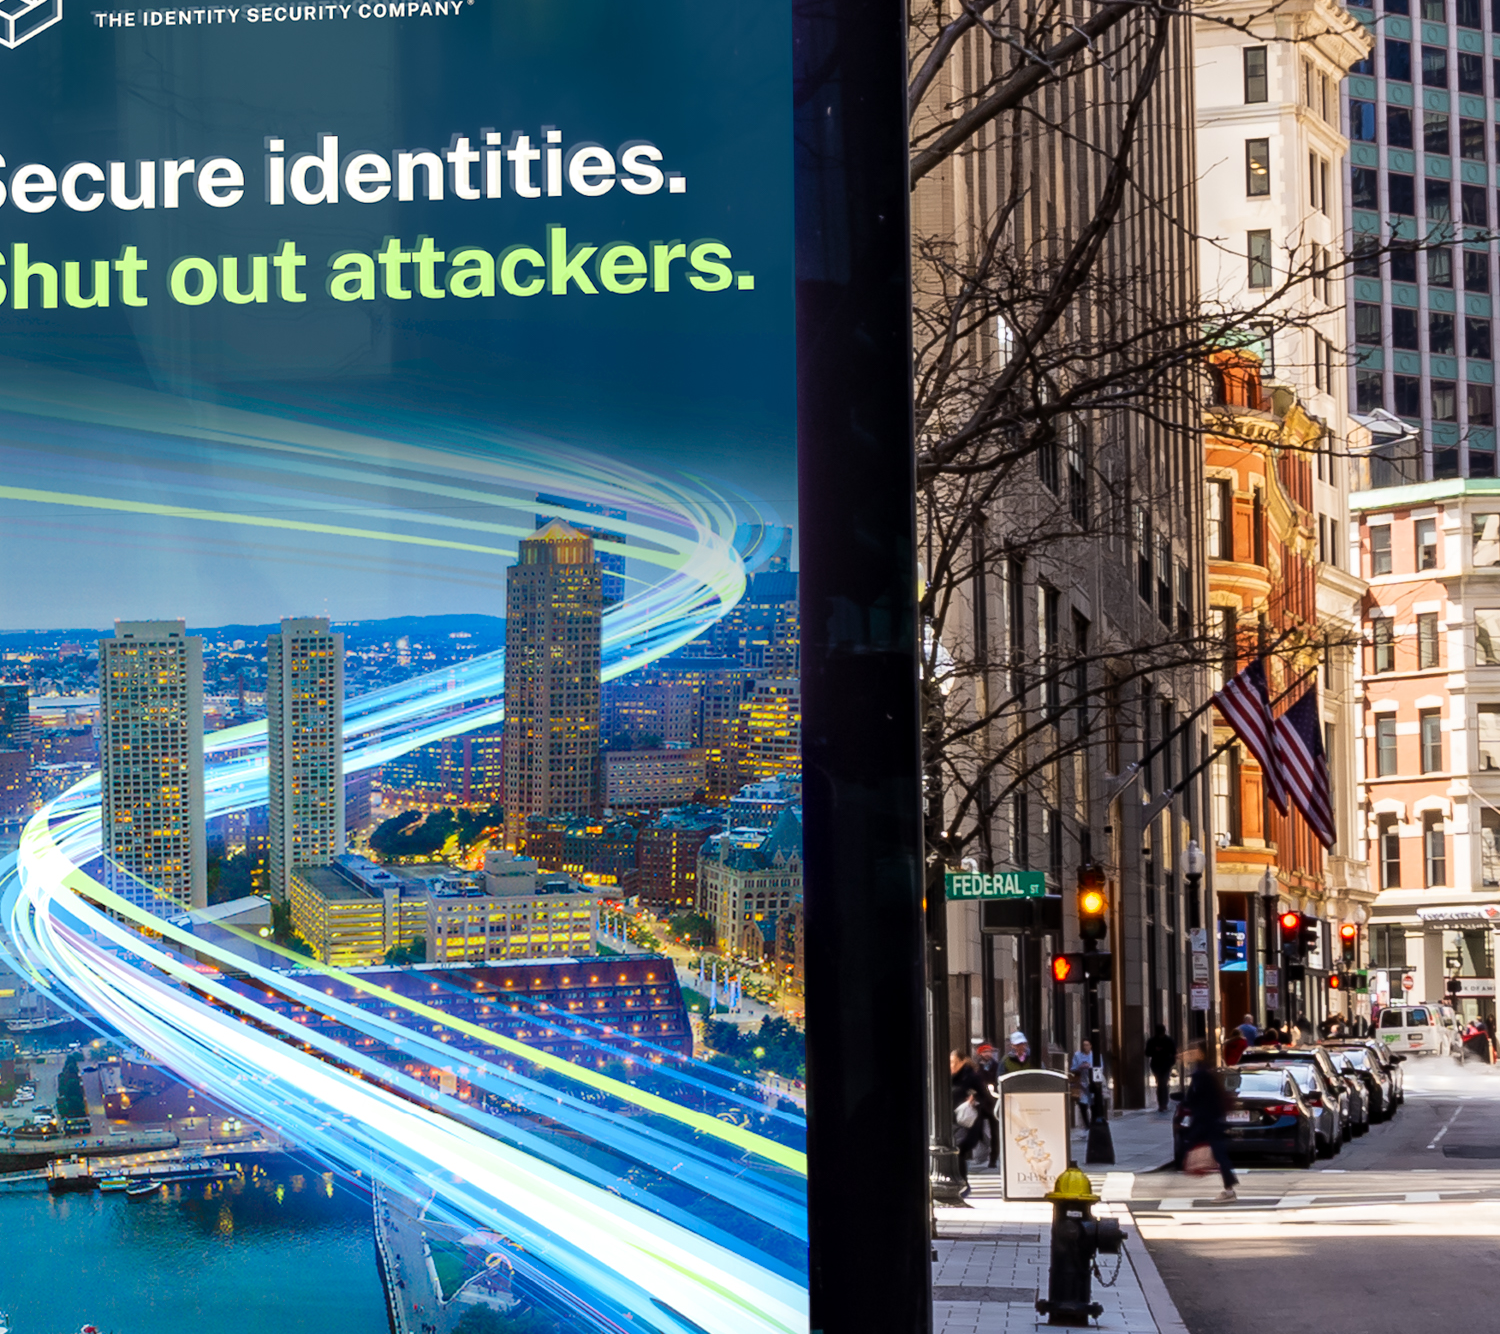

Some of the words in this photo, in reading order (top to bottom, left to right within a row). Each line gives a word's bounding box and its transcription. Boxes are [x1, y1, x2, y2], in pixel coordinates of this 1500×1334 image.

[95, 12, 136, 28] THE
[143, 7, 240, 26] IDENTITY
[246, 4, 352, 23] SECURITY
[269, 130, 687, 206] identities.
[171, 241, 306, 305] out
[329, 226, 755, 300] attackers.
[952, 874, 1024, 896] FEDERAL
[1030, 884, 1040, 894] ST
